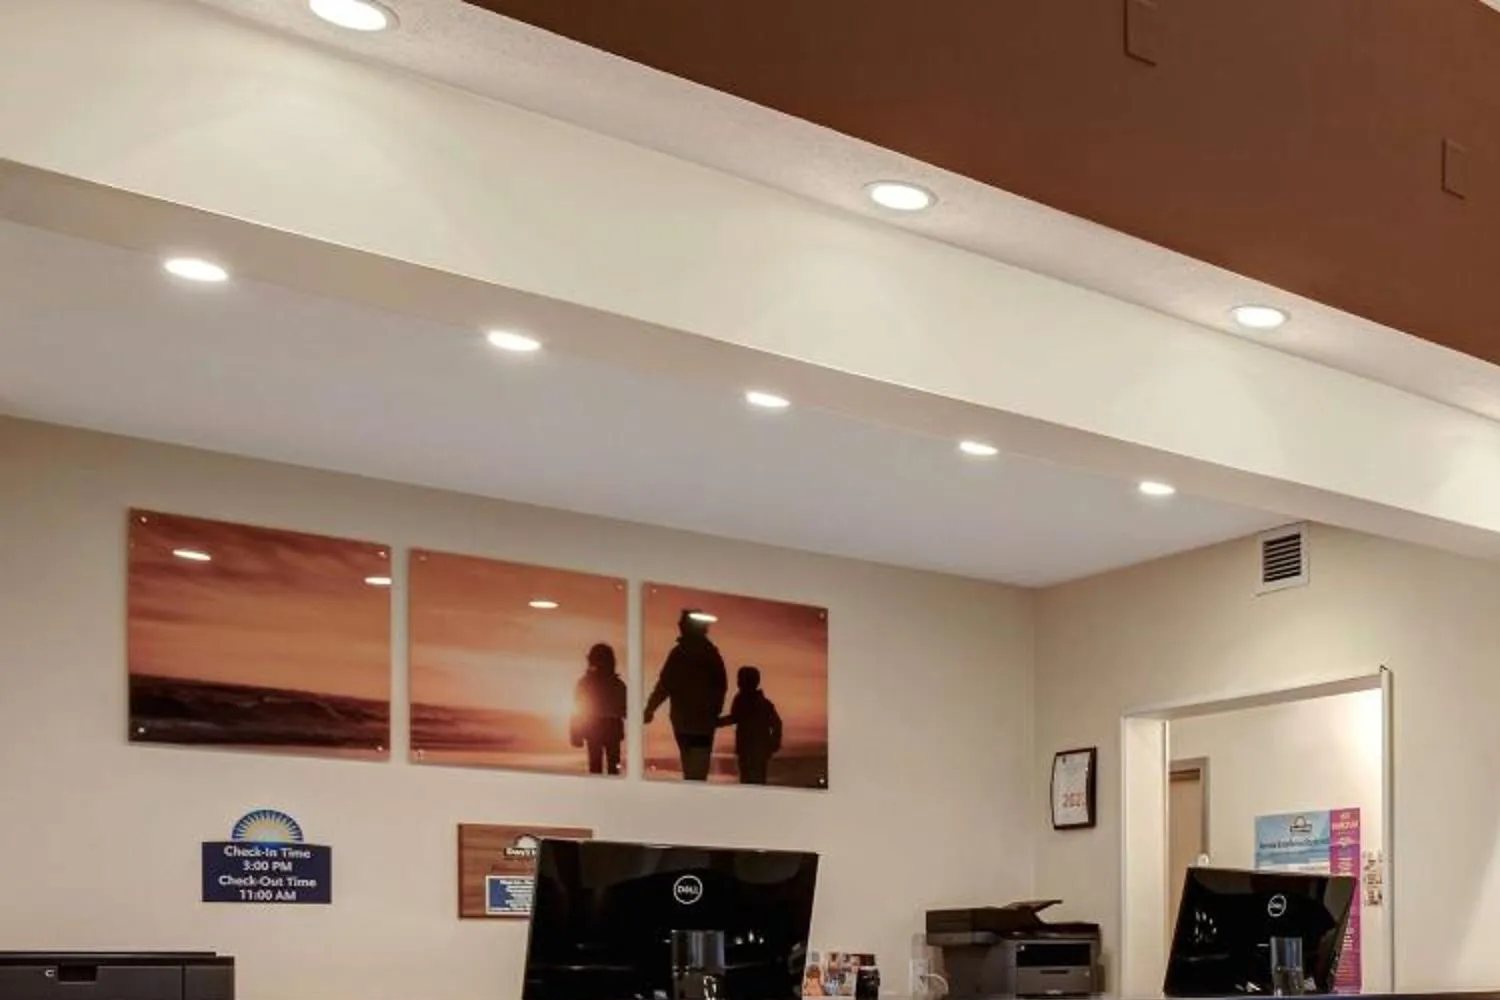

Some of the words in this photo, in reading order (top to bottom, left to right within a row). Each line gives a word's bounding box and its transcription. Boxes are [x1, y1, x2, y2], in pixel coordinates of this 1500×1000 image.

[223, 845, 277, 858] Check-In
[280, 847, 311, 859] Time
[243, 861, 269, 872] 3:00
[271, 861, 293, 872] PM
[218, 875, 283, 887] Check-Out
[286, 876, 317, 888] Time
[239, 889, 273, 900] 11:00
[275, 890, 297, 901] AM
